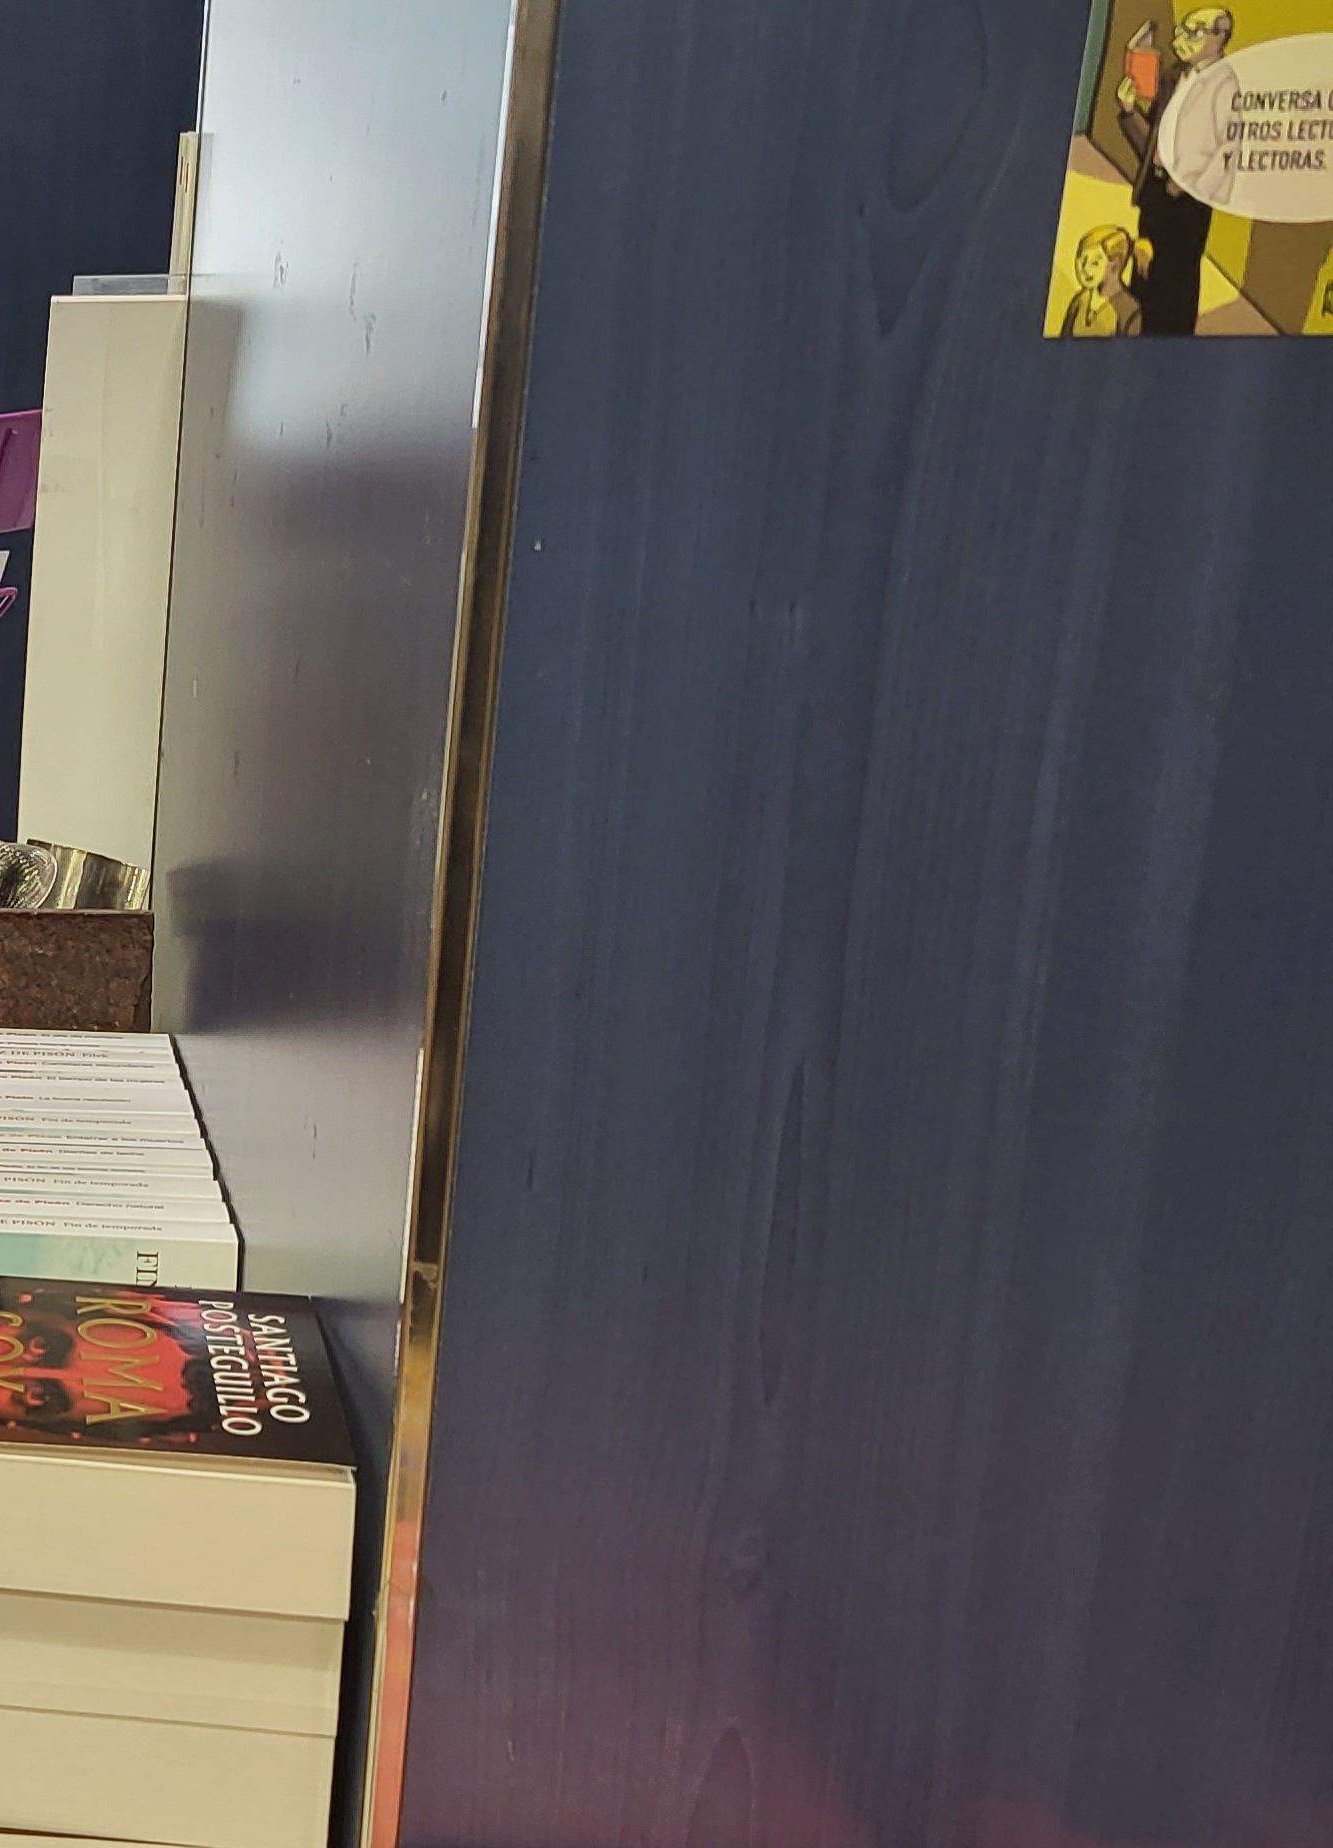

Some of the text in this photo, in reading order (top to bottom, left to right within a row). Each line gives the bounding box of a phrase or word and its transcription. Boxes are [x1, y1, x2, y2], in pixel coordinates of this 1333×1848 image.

[1231, 90, 1321, 111] CONVERSA
[1226, 120, 1282, 140] OTROS
[1223, 150, 1233, 171] Y
[101, 1223, 162, 1231] temporada
[75, 1295, 168, 1425] ROMA
[198, 1300, 262, 1436] POSTEGUILLO
[247, 1313, 310, 1423] SANTIAGO
